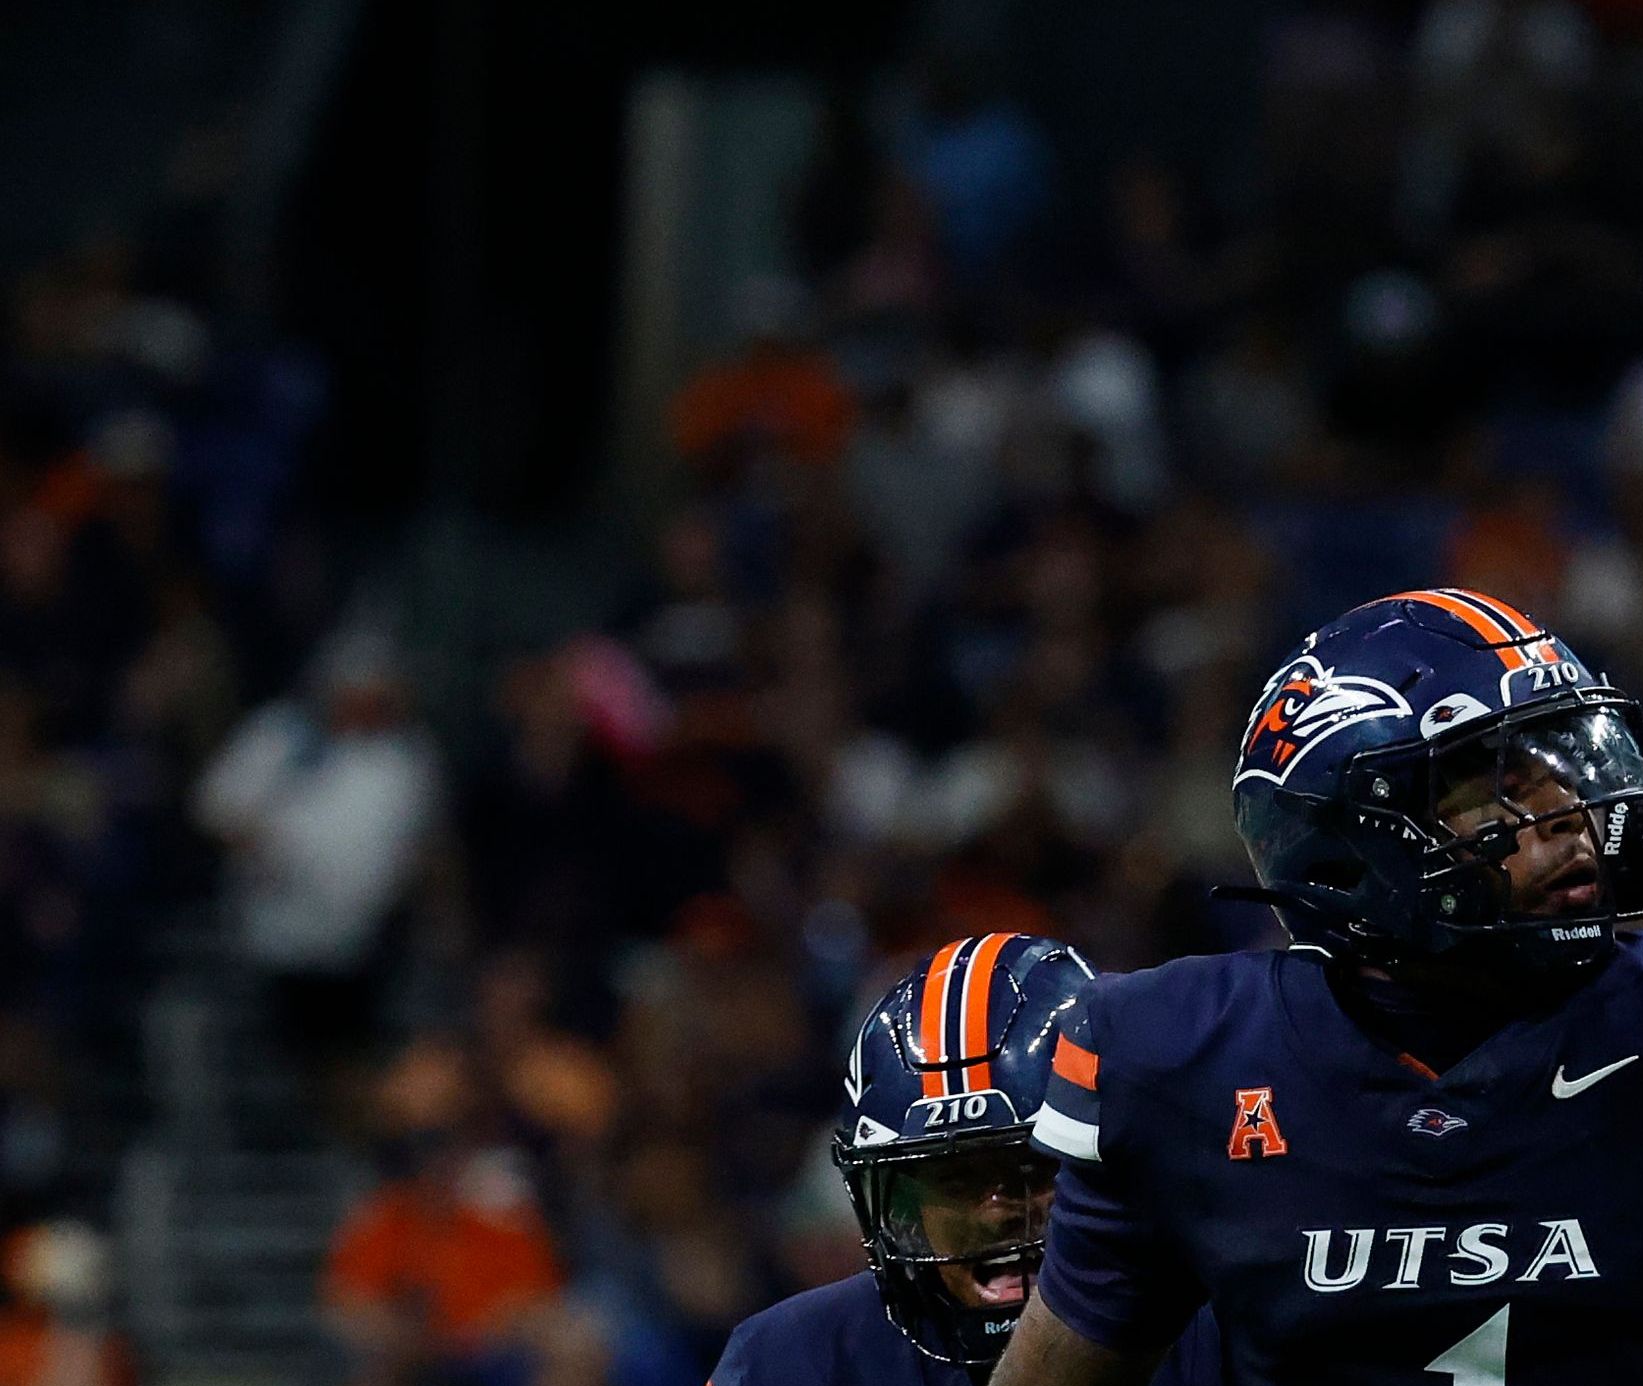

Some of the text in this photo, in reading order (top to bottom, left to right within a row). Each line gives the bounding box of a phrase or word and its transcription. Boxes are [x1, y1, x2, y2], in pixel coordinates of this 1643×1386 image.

[1527, 661, 1580, 692] 210
[1603, 802, 1630, 856] Ridde
[923, 1095, 988, 1129] 210
[1301, 1218, 1601, 1293] UTSA
